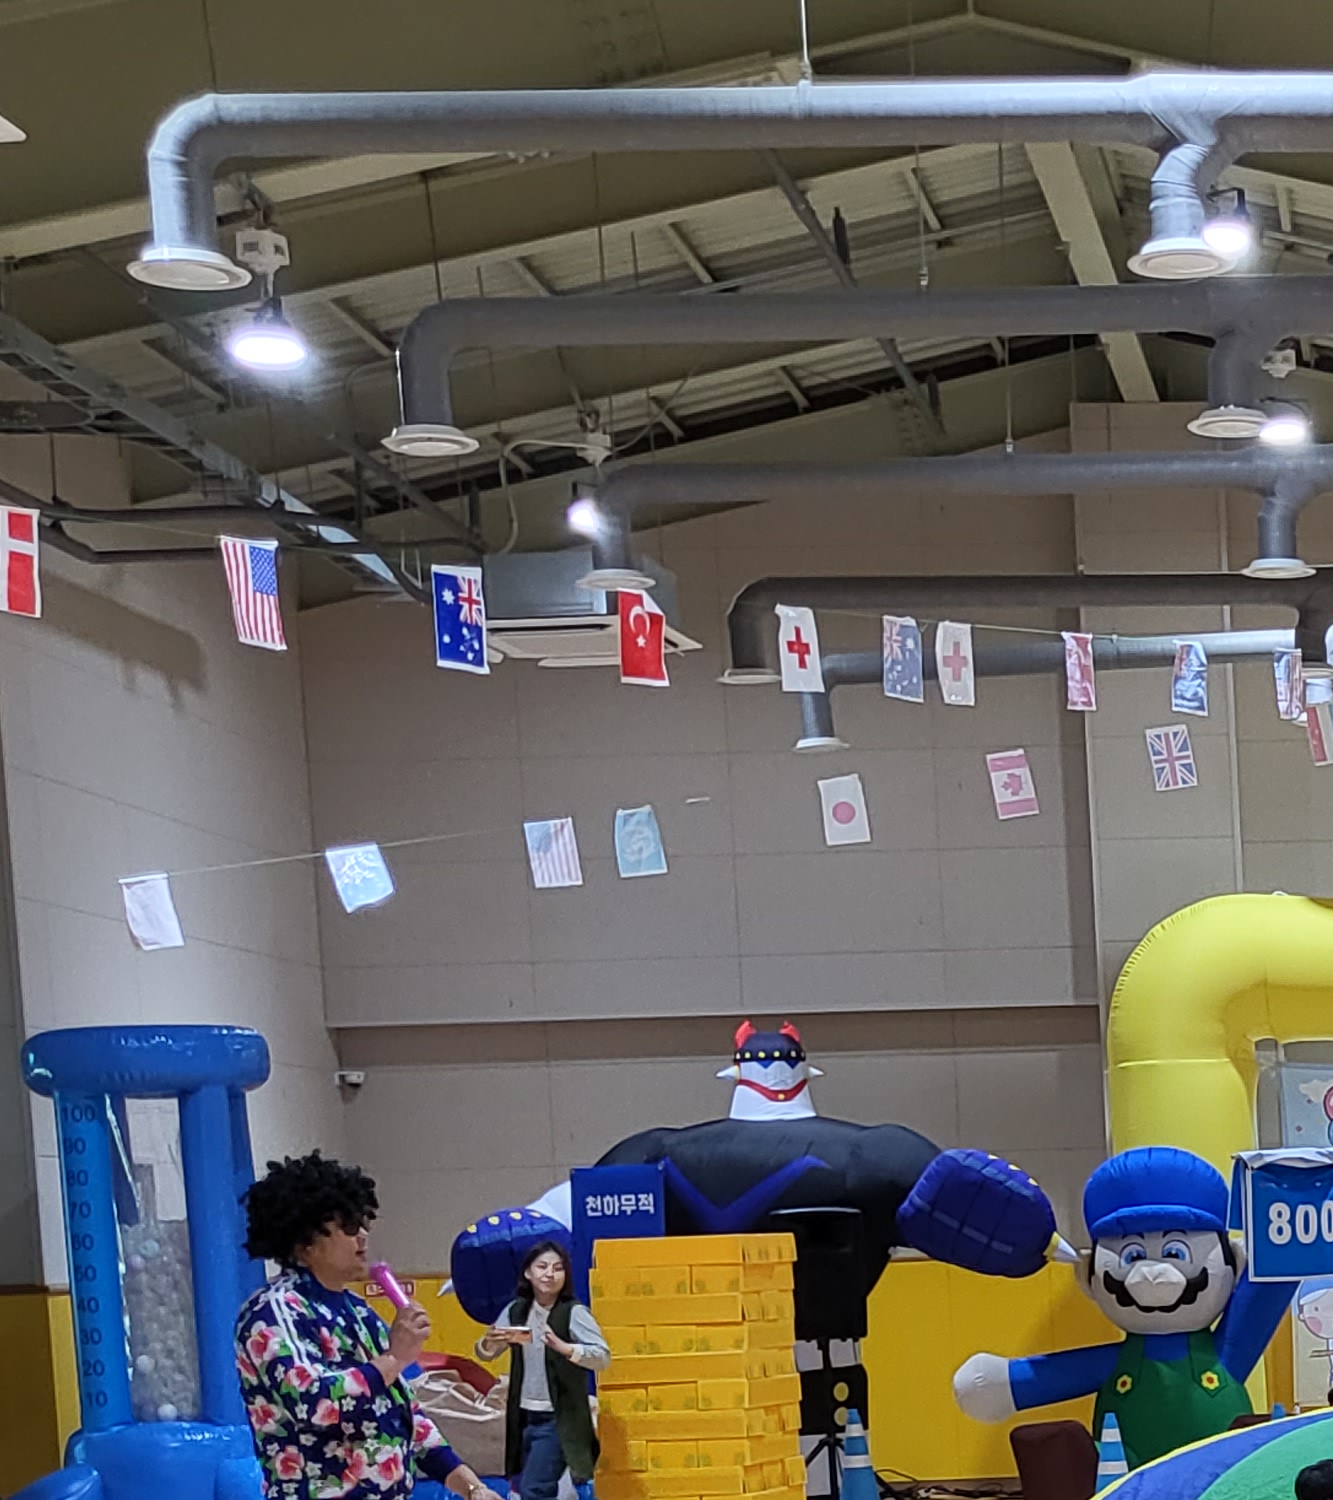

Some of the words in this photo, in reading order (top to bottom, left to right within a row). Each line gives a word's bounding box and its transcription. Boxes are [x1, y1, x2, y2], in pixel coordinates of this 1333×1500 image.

[61, 1104, 95, 1123] 100
[70, 1200, 92, 1219] 70
[585, 1192, 655, 1217] 천하무적
[80, 1327, 102, 1346] 30
[83, 1359, 105, 1377] 20
[86, 1390, 108, 1408] 10
